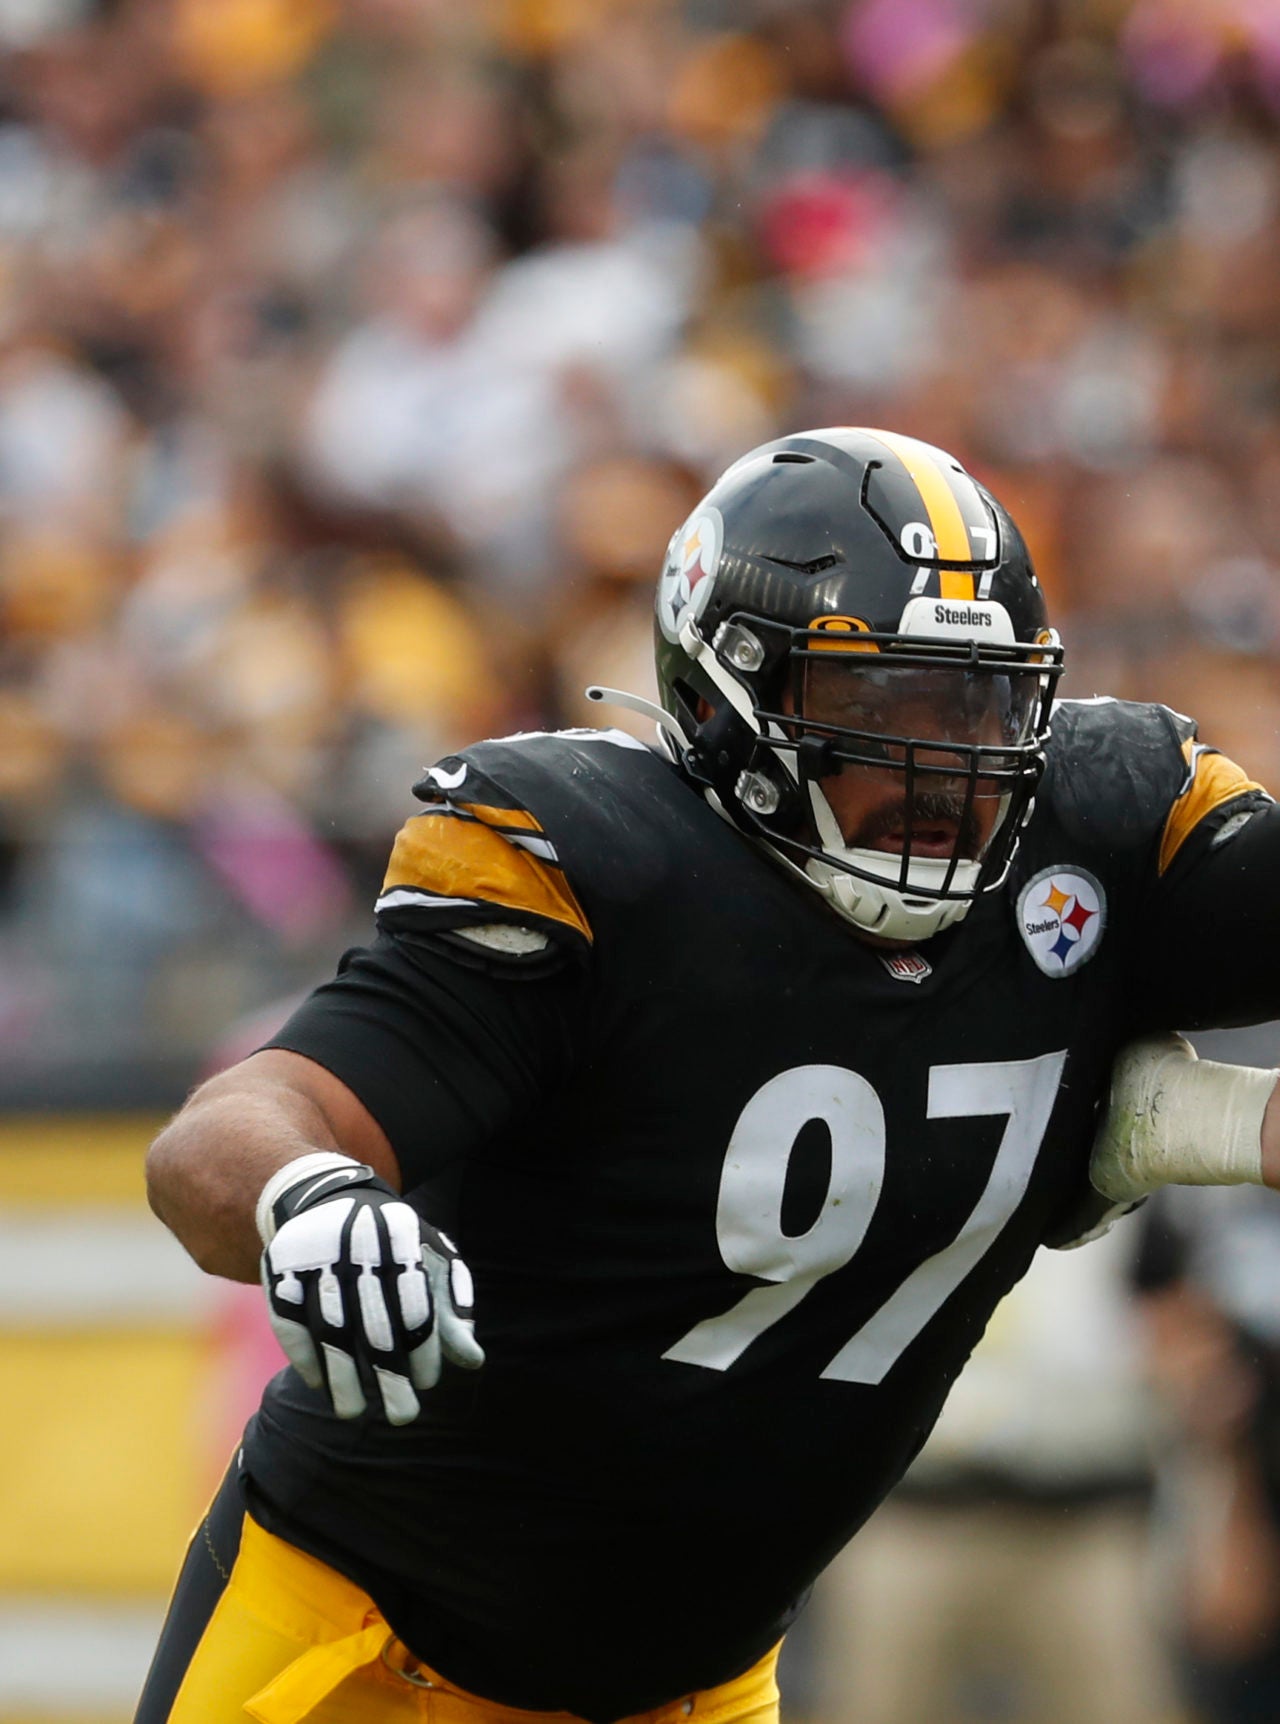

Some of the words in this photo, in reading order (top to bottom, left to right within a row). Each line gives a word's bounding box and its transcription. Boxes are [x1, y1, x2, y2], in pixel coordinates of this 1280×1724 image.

[900, 521, 998, 599] 97
[934, 604, 992, 627] Steelers
[1026, 919, 1060, 936] Steelers
[661, 1048, 1069, 1386] 97
